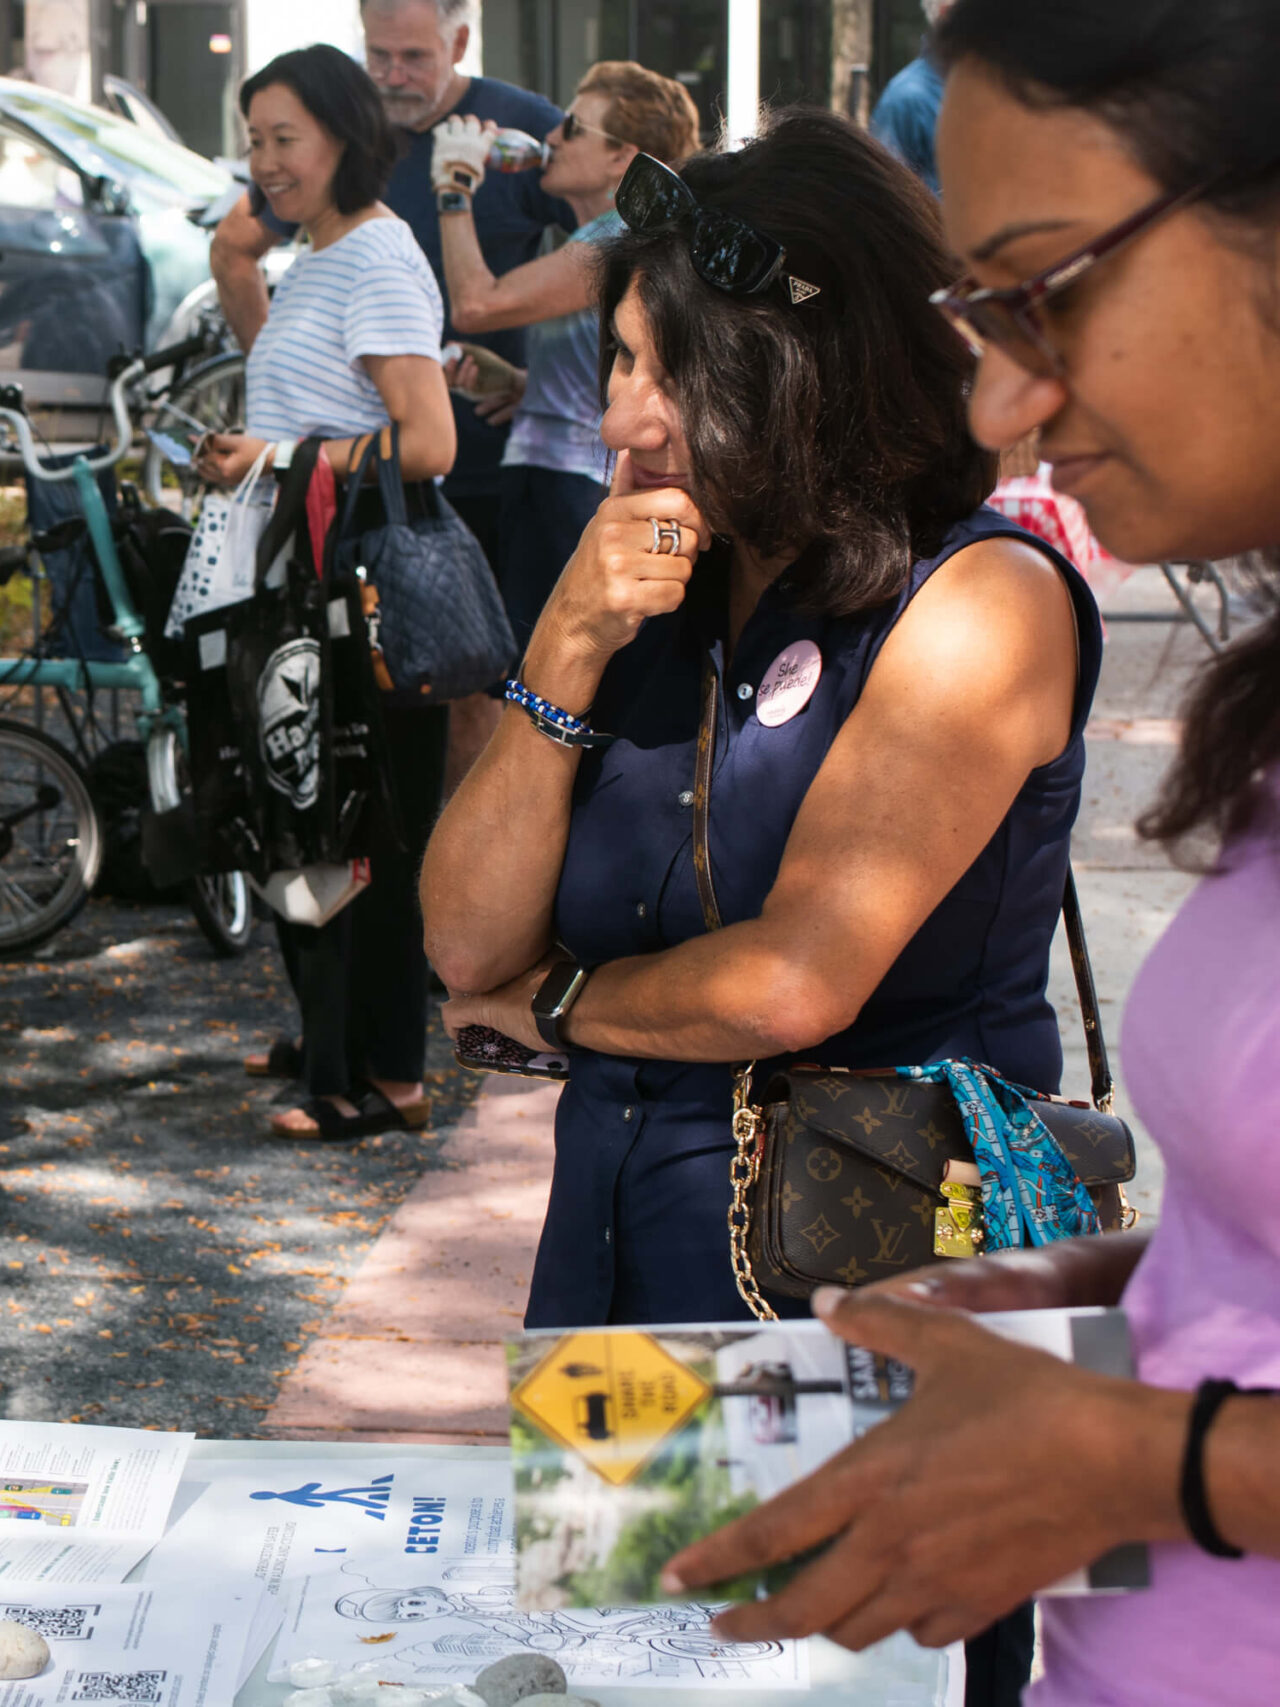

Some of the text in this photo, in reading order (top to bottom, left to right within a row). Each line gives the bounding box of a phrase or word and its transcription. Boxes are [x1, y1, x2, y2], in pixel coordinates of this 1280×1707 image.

[758, 671, 813, 700] se puede!
[778, 662, 799, 677] She
[868, 1217, 911, 1265] LV
[619, 1370, 639, 1420] SHARE
[641, 1380, 657, 1408] THE
[662, 1370, 678, 1414] ROAD
